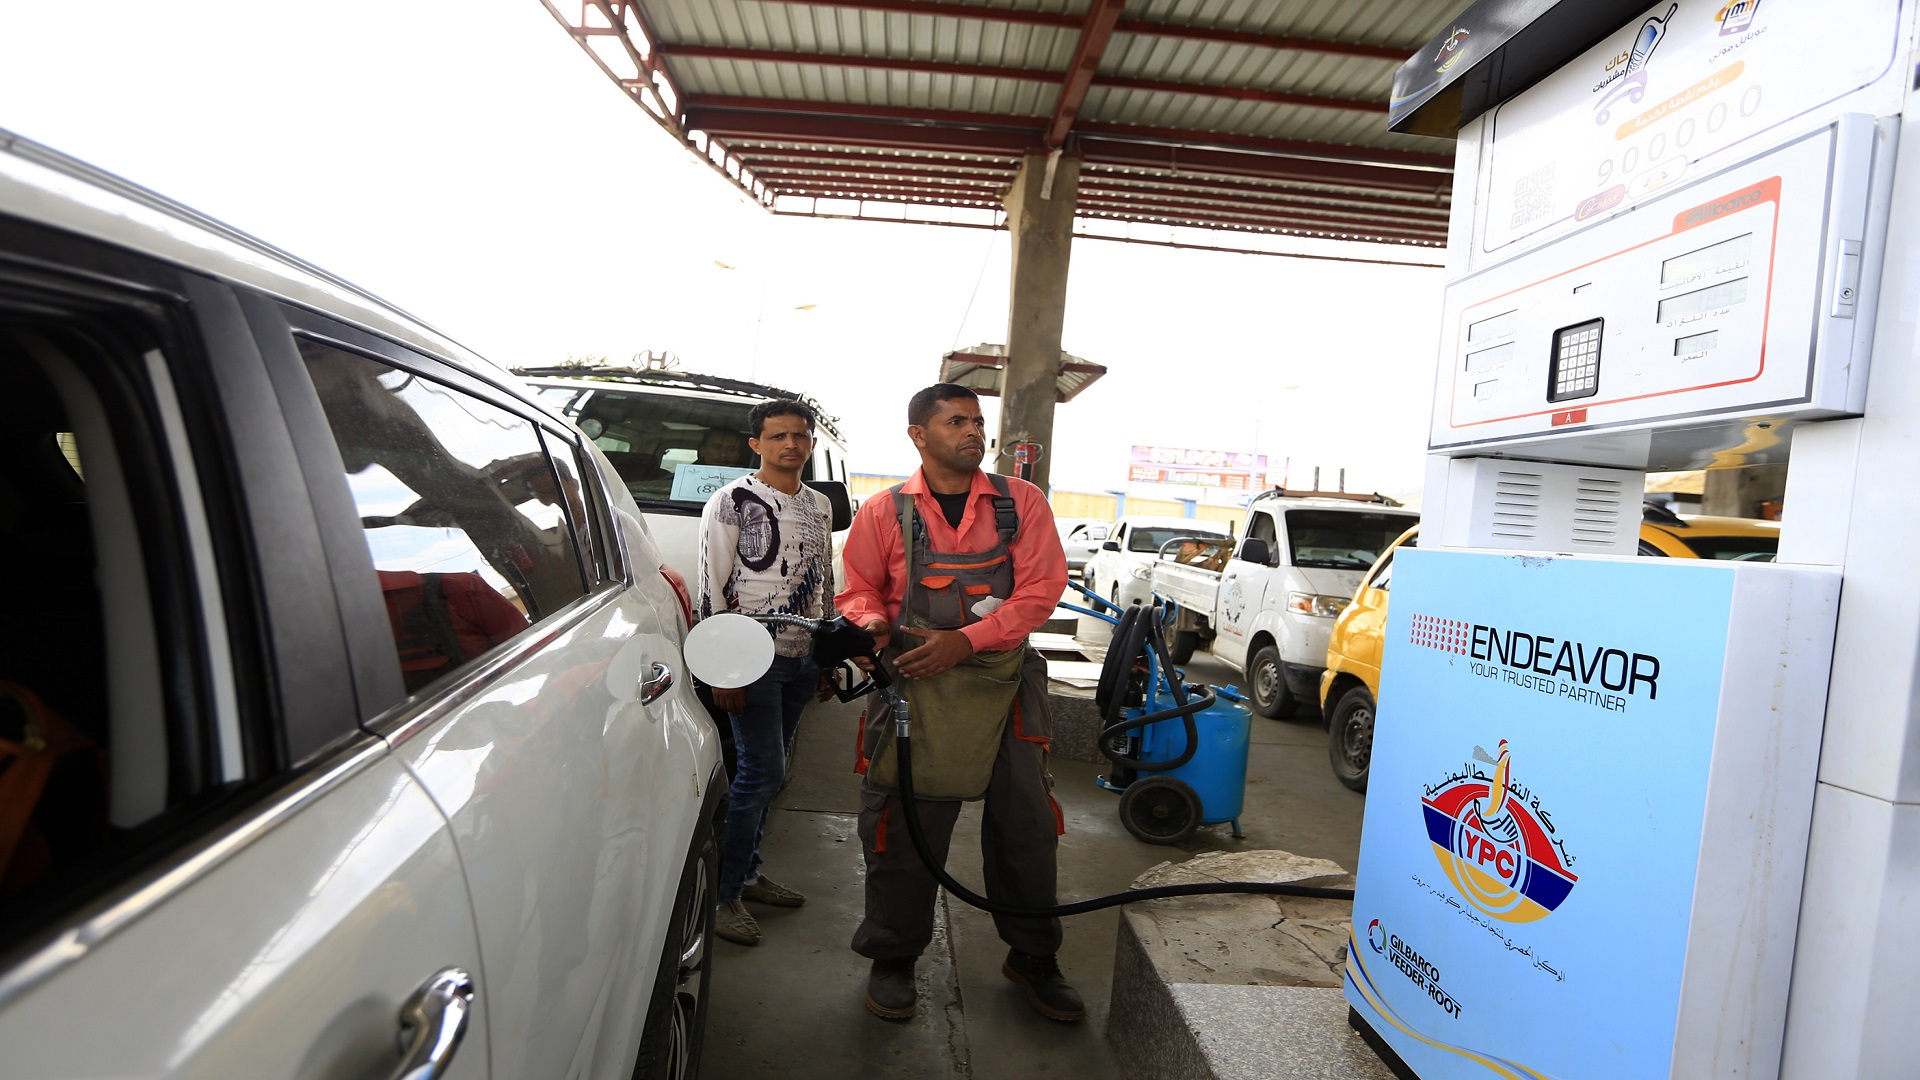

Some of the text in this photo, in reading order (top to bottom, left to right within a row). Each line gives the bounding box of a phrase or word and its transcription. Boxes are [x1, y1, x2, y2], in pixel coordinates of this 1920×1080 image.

[1735, 26, 1768, 48] موبايل
[1604, 50, 1630, 72] كاك
[1592, 69, 1625, 93] مشتريات
[1634, 77, 1719, 127] رقم نقطة الخدمة
[1712, 308, 1731, 317] عدد
[1680, 350, 1708, 364] السعر
[1565, 412, 1572, 424] A
[1470, 624, 1660, 700] ENDEAVOR
[1469, 661, 1627, 713] YOUR TRUSTED PARTNER
[1423, 762, 1472, 797] اليمنية
[1530, 795, 1578, 867] شركة
[1464, 829, 1515, 879] YPC
[1390, 934, 1440, 983] GILBARCO
[1533, 955, 1566, 983] الوكيل
[1388, 949, 1462, 1020] VEEDER-ROOT
